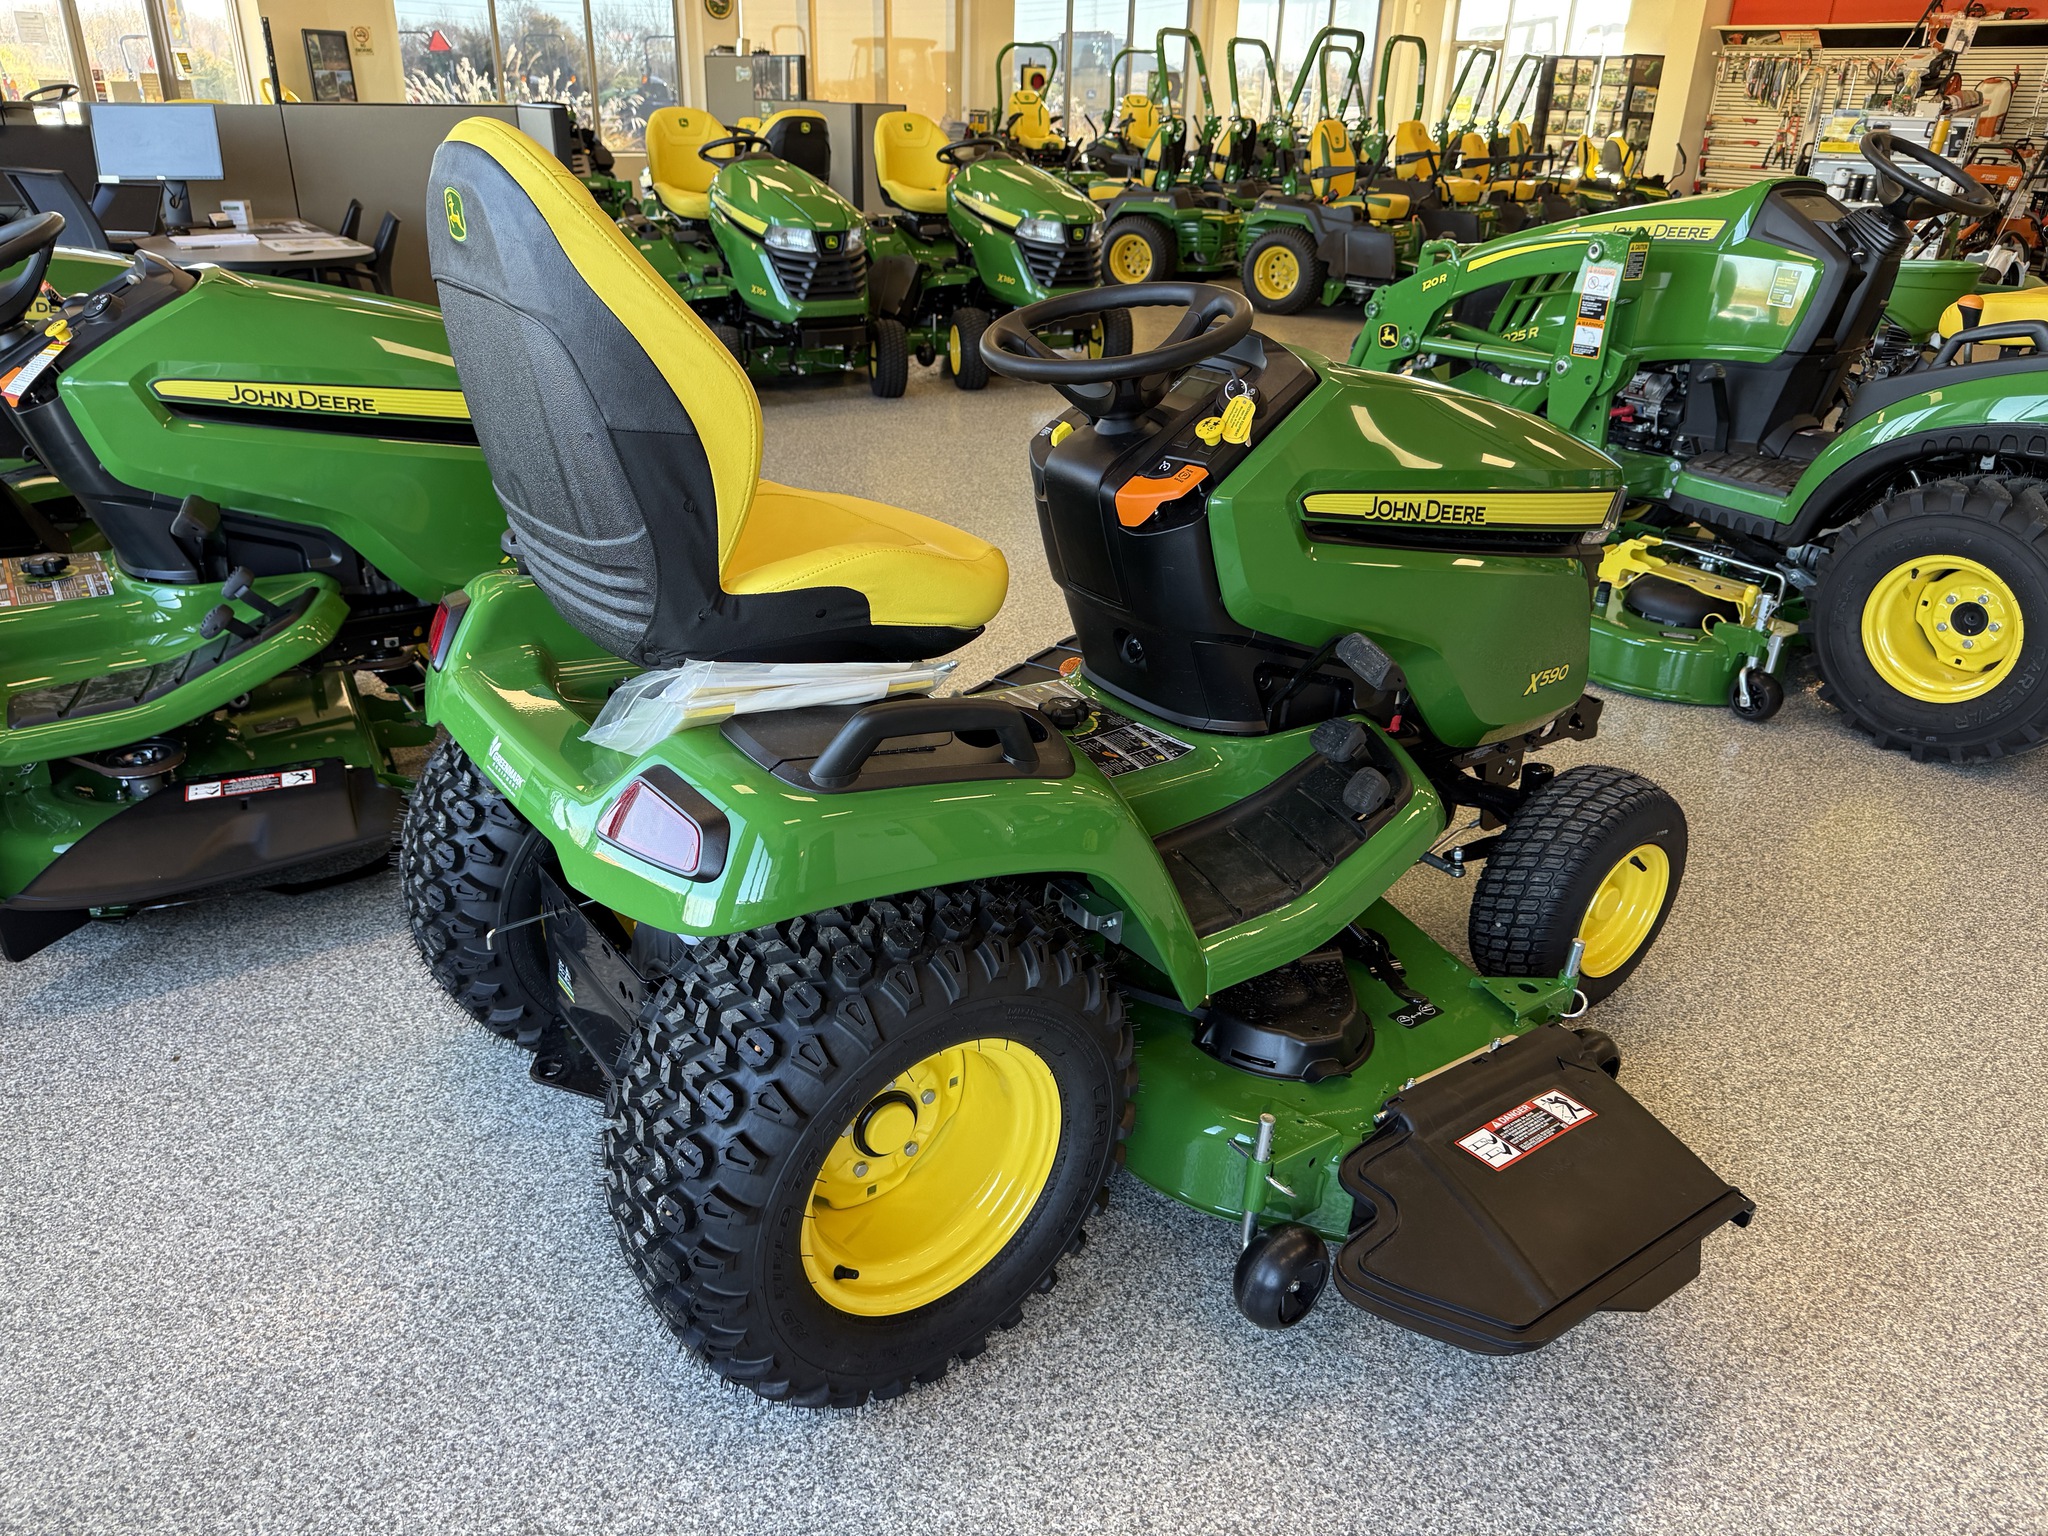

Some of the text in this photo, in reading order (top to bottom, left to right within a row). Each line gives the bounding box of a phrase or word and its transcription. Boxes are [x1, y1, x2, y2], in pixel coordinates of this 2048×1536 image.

[1655, 224, 1711, 239] DEERE
[1422, 273, 1448, 292] 120 R
[1528, 326, 1540, 339] R
[1581, 321, 1604, 330] WARNING
[228, 385, 377, 413] JOHN DEERE
[1365, 496, 1487, 523] JOHN DEERE
[1522, 663, 1570, 697] X590
[492, 751, 526, 789] GREENMARK
[1499, 1104, 1532, 1125] DANGER
[1055, 1083, 1108, 1237] CARLSTAR
